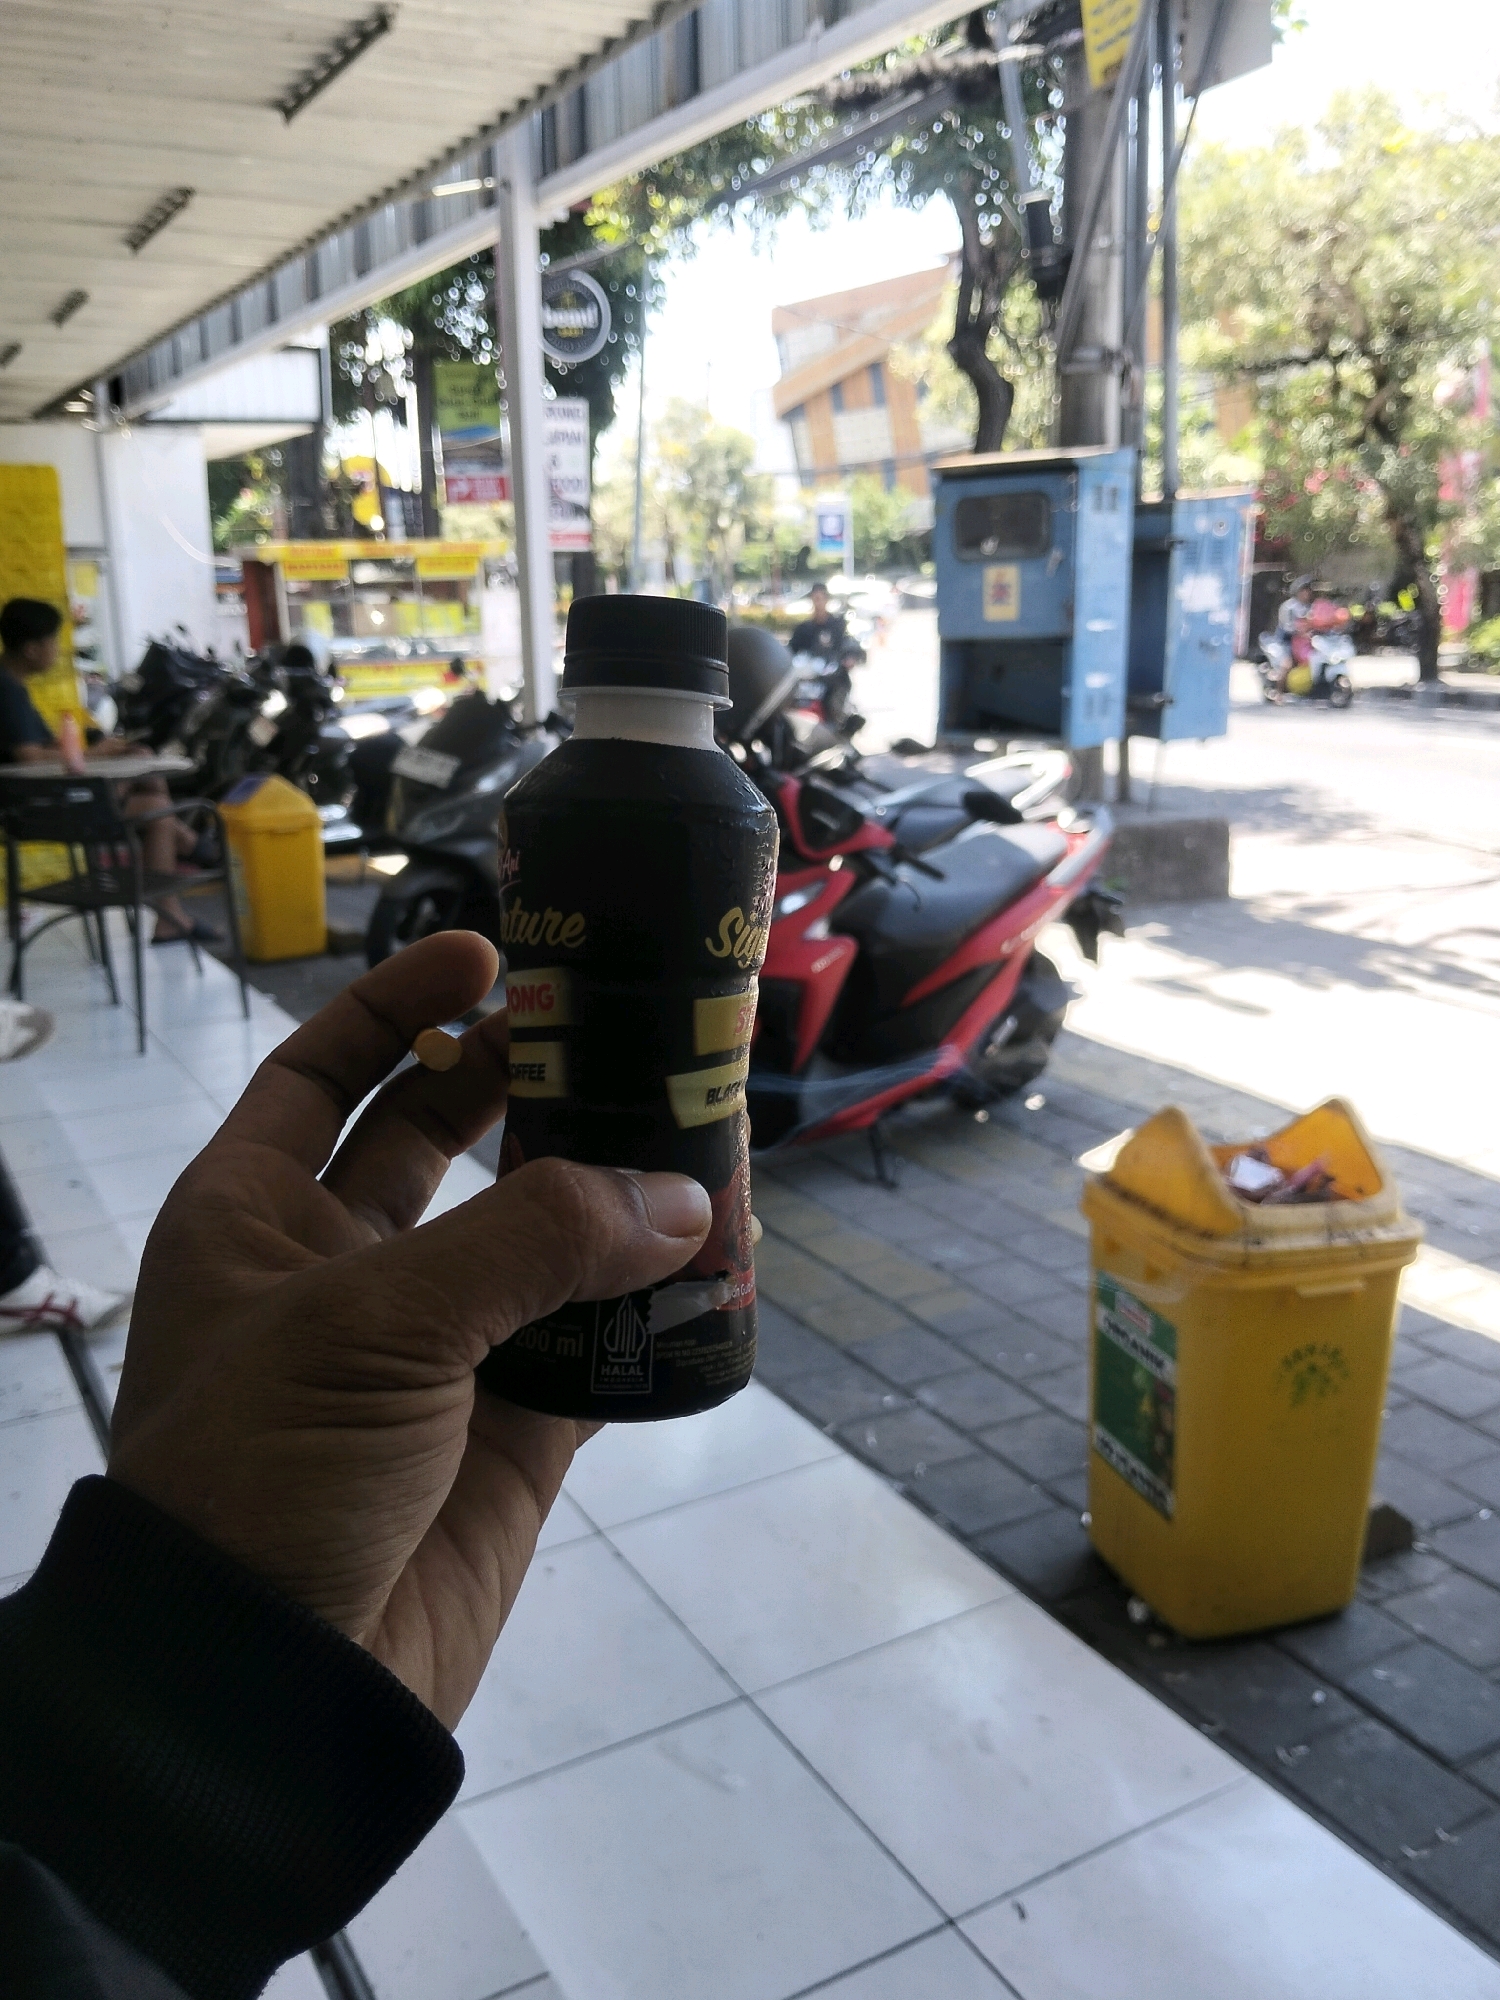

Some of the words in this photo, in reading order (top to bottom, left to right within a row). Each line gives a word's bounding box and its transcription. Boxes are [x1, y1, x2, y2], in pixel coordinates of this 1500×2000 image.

[515, 1326, 550, 1353] 200
[556, 1332, 584, 1358] ml
[601, 1364, 644, 1376] HALAL
